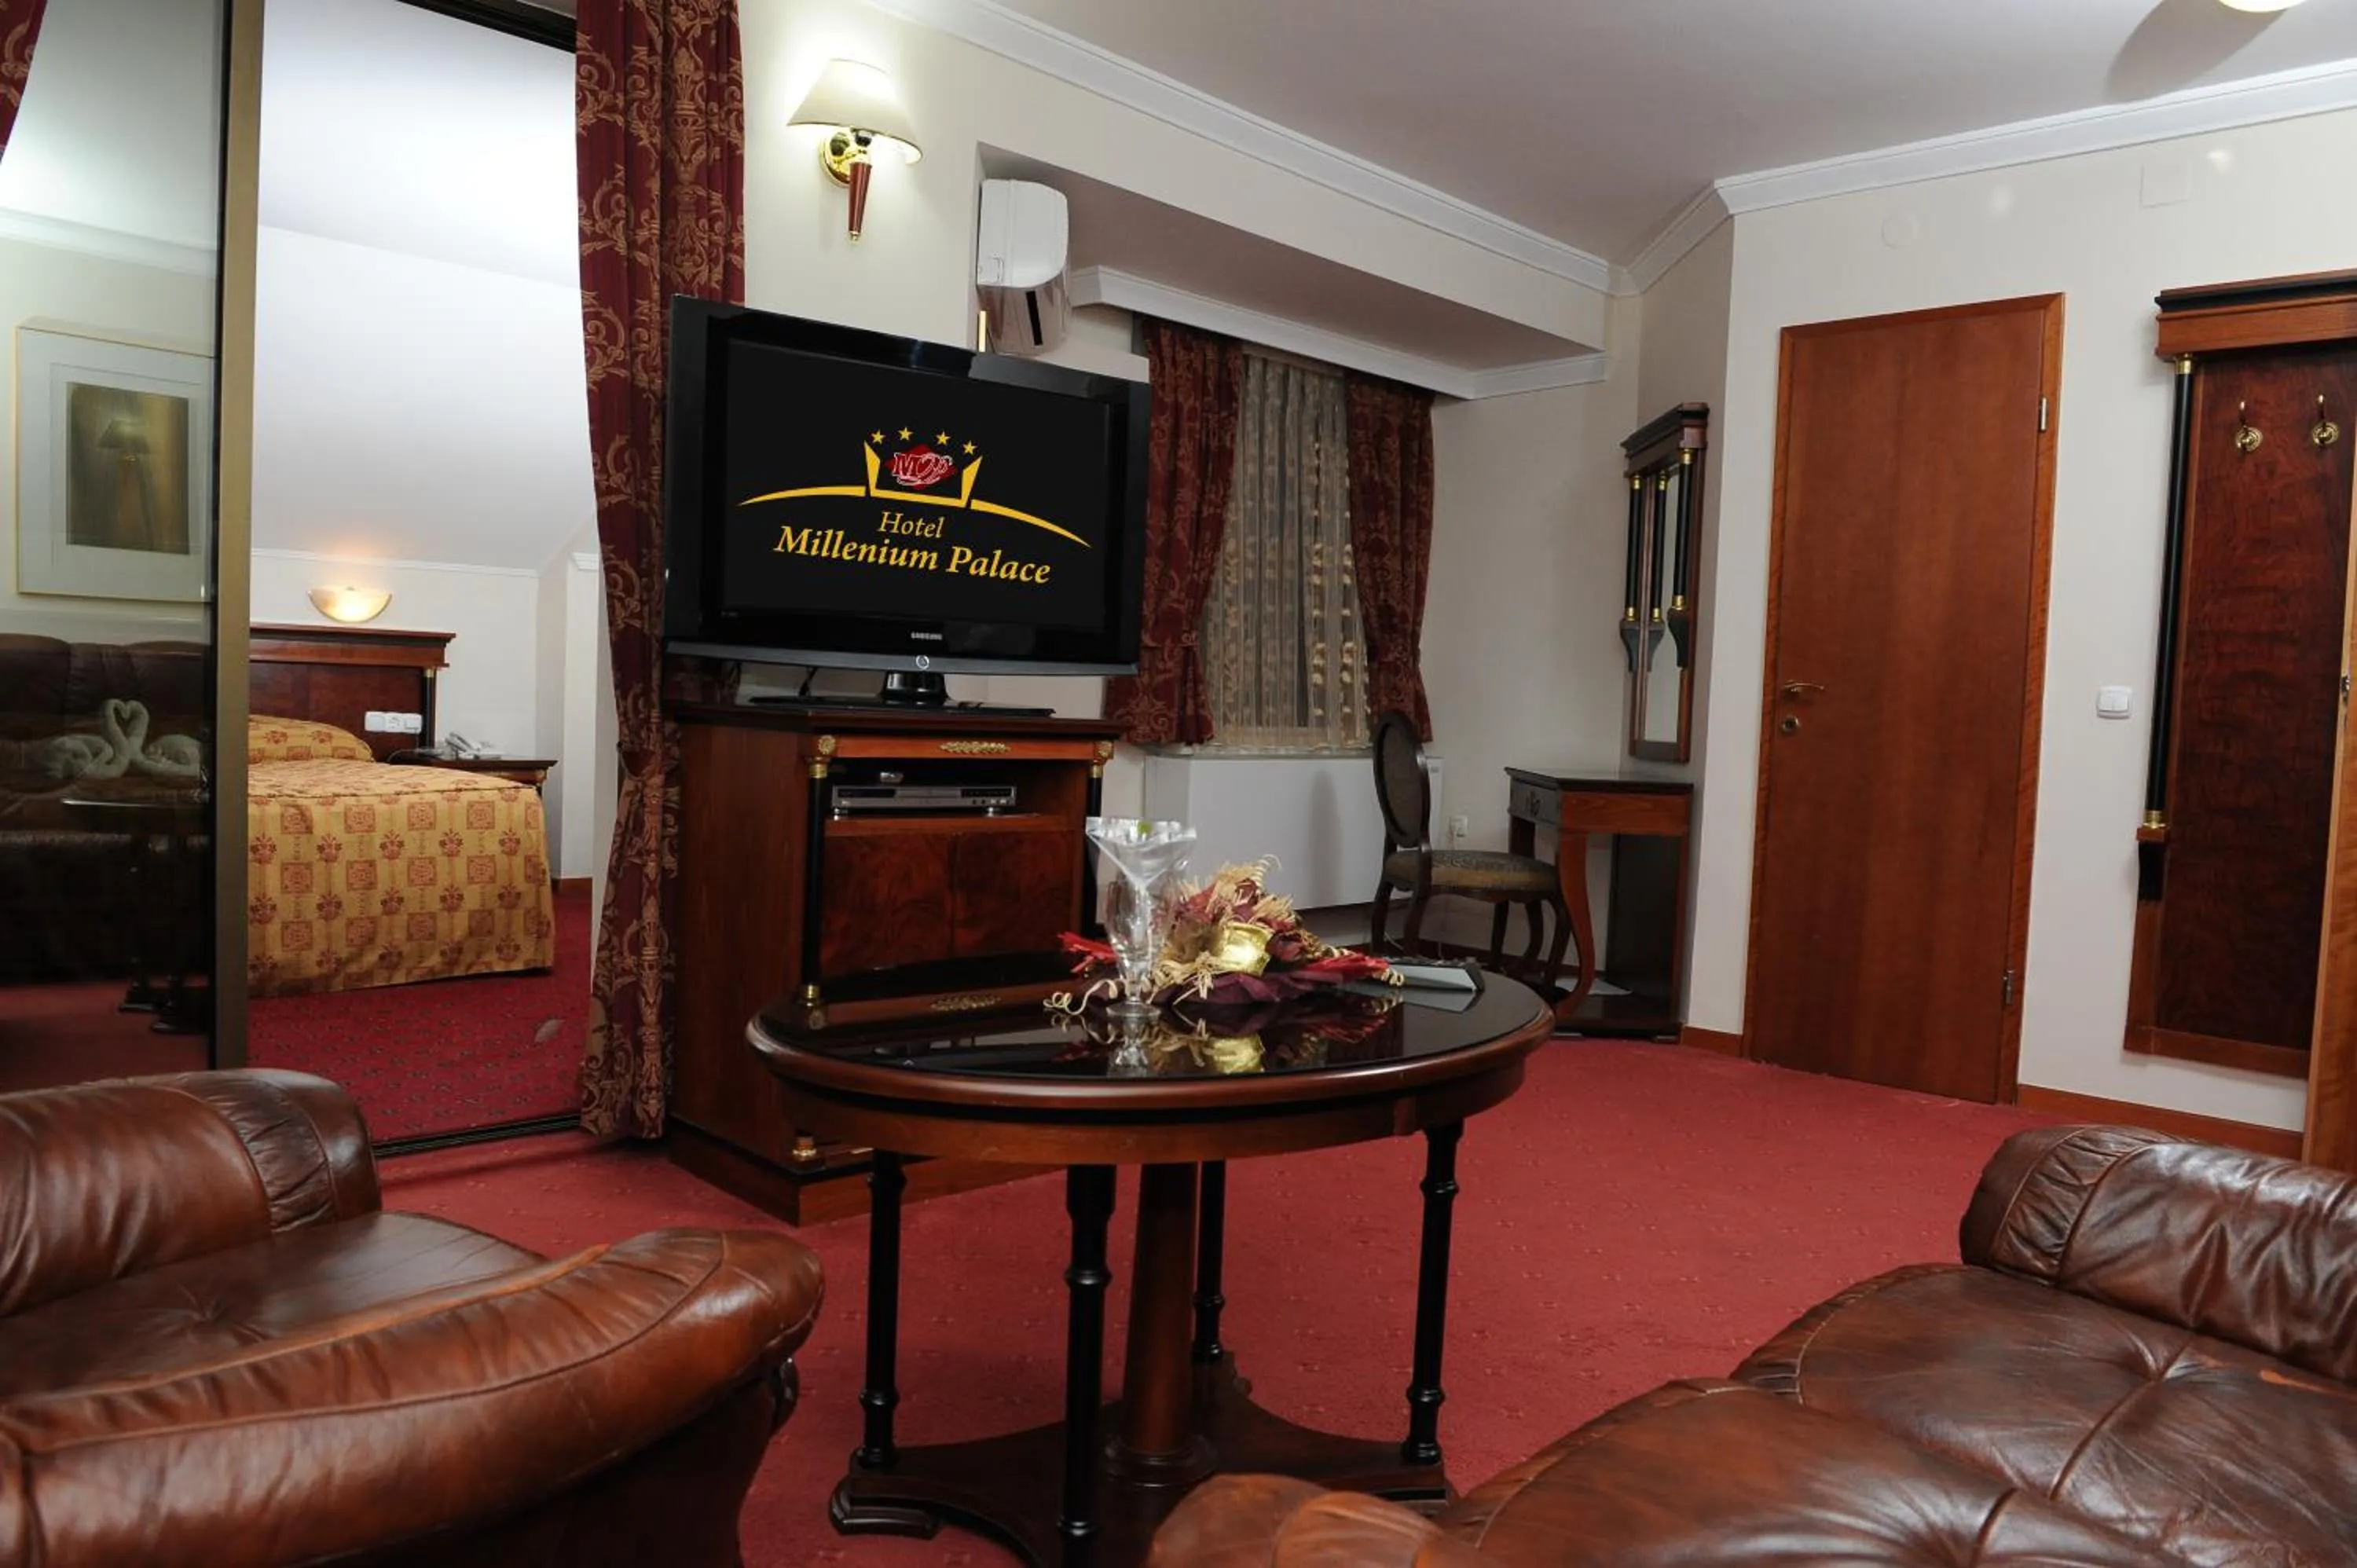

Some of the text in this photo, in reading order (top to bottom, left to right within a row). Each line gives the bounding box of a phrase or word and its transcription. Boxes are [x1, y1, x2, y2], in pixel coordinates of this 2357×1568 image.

[878, 511, 945, 539] Hotel
[774, 526, 1051, 584] Millenium Palace
